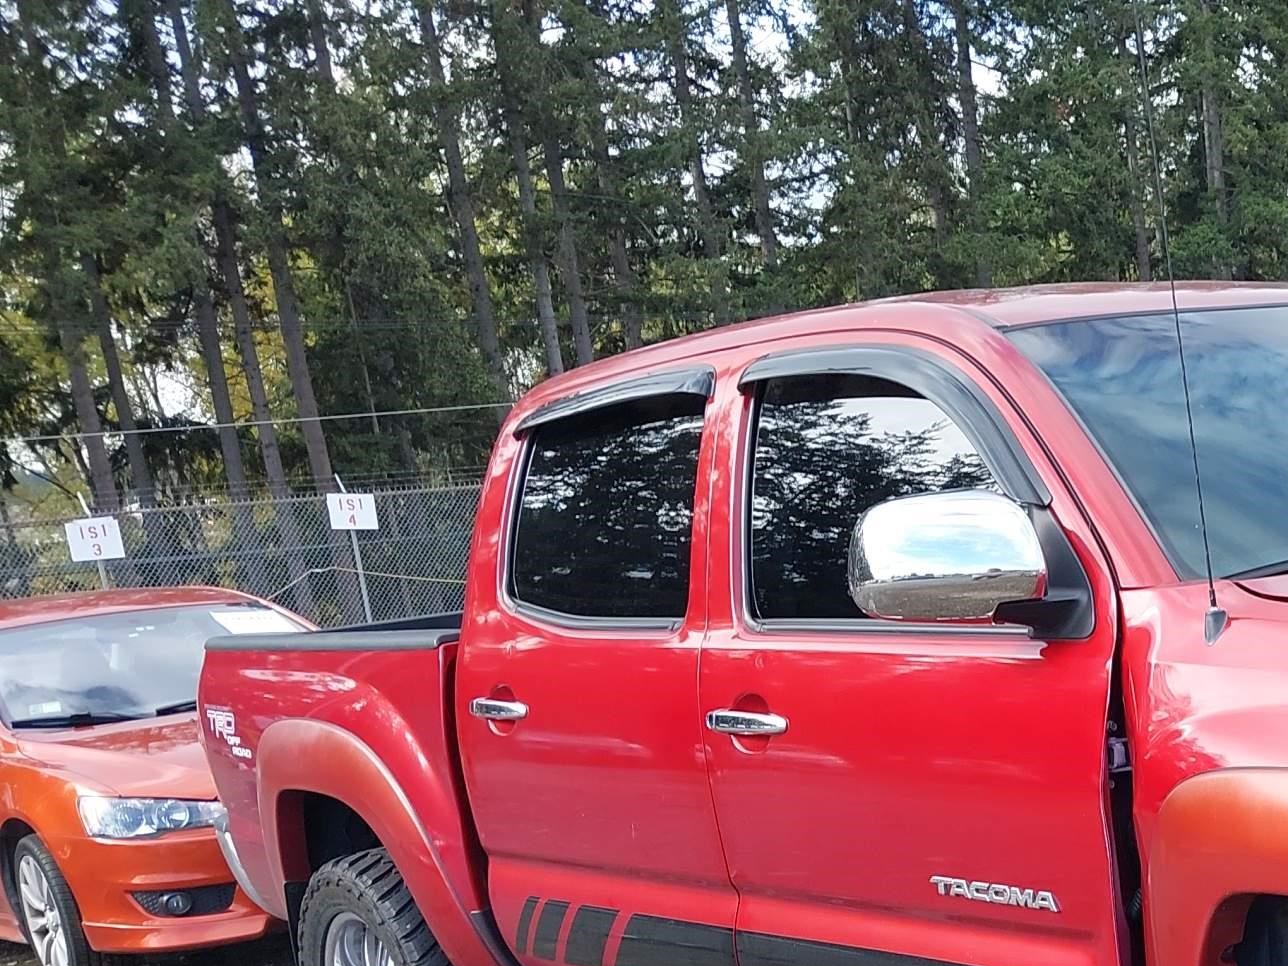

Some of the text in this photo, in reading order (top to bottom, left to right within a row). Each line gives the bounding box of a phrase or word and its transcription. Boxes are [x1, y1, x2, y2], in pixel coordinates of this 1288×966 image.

[348, 513, 357, 527] 4
[92, 543, 103, 557] 3
[206, 709, 236, 739] TRD
[929, 876, 1061, 912] TACOMA
